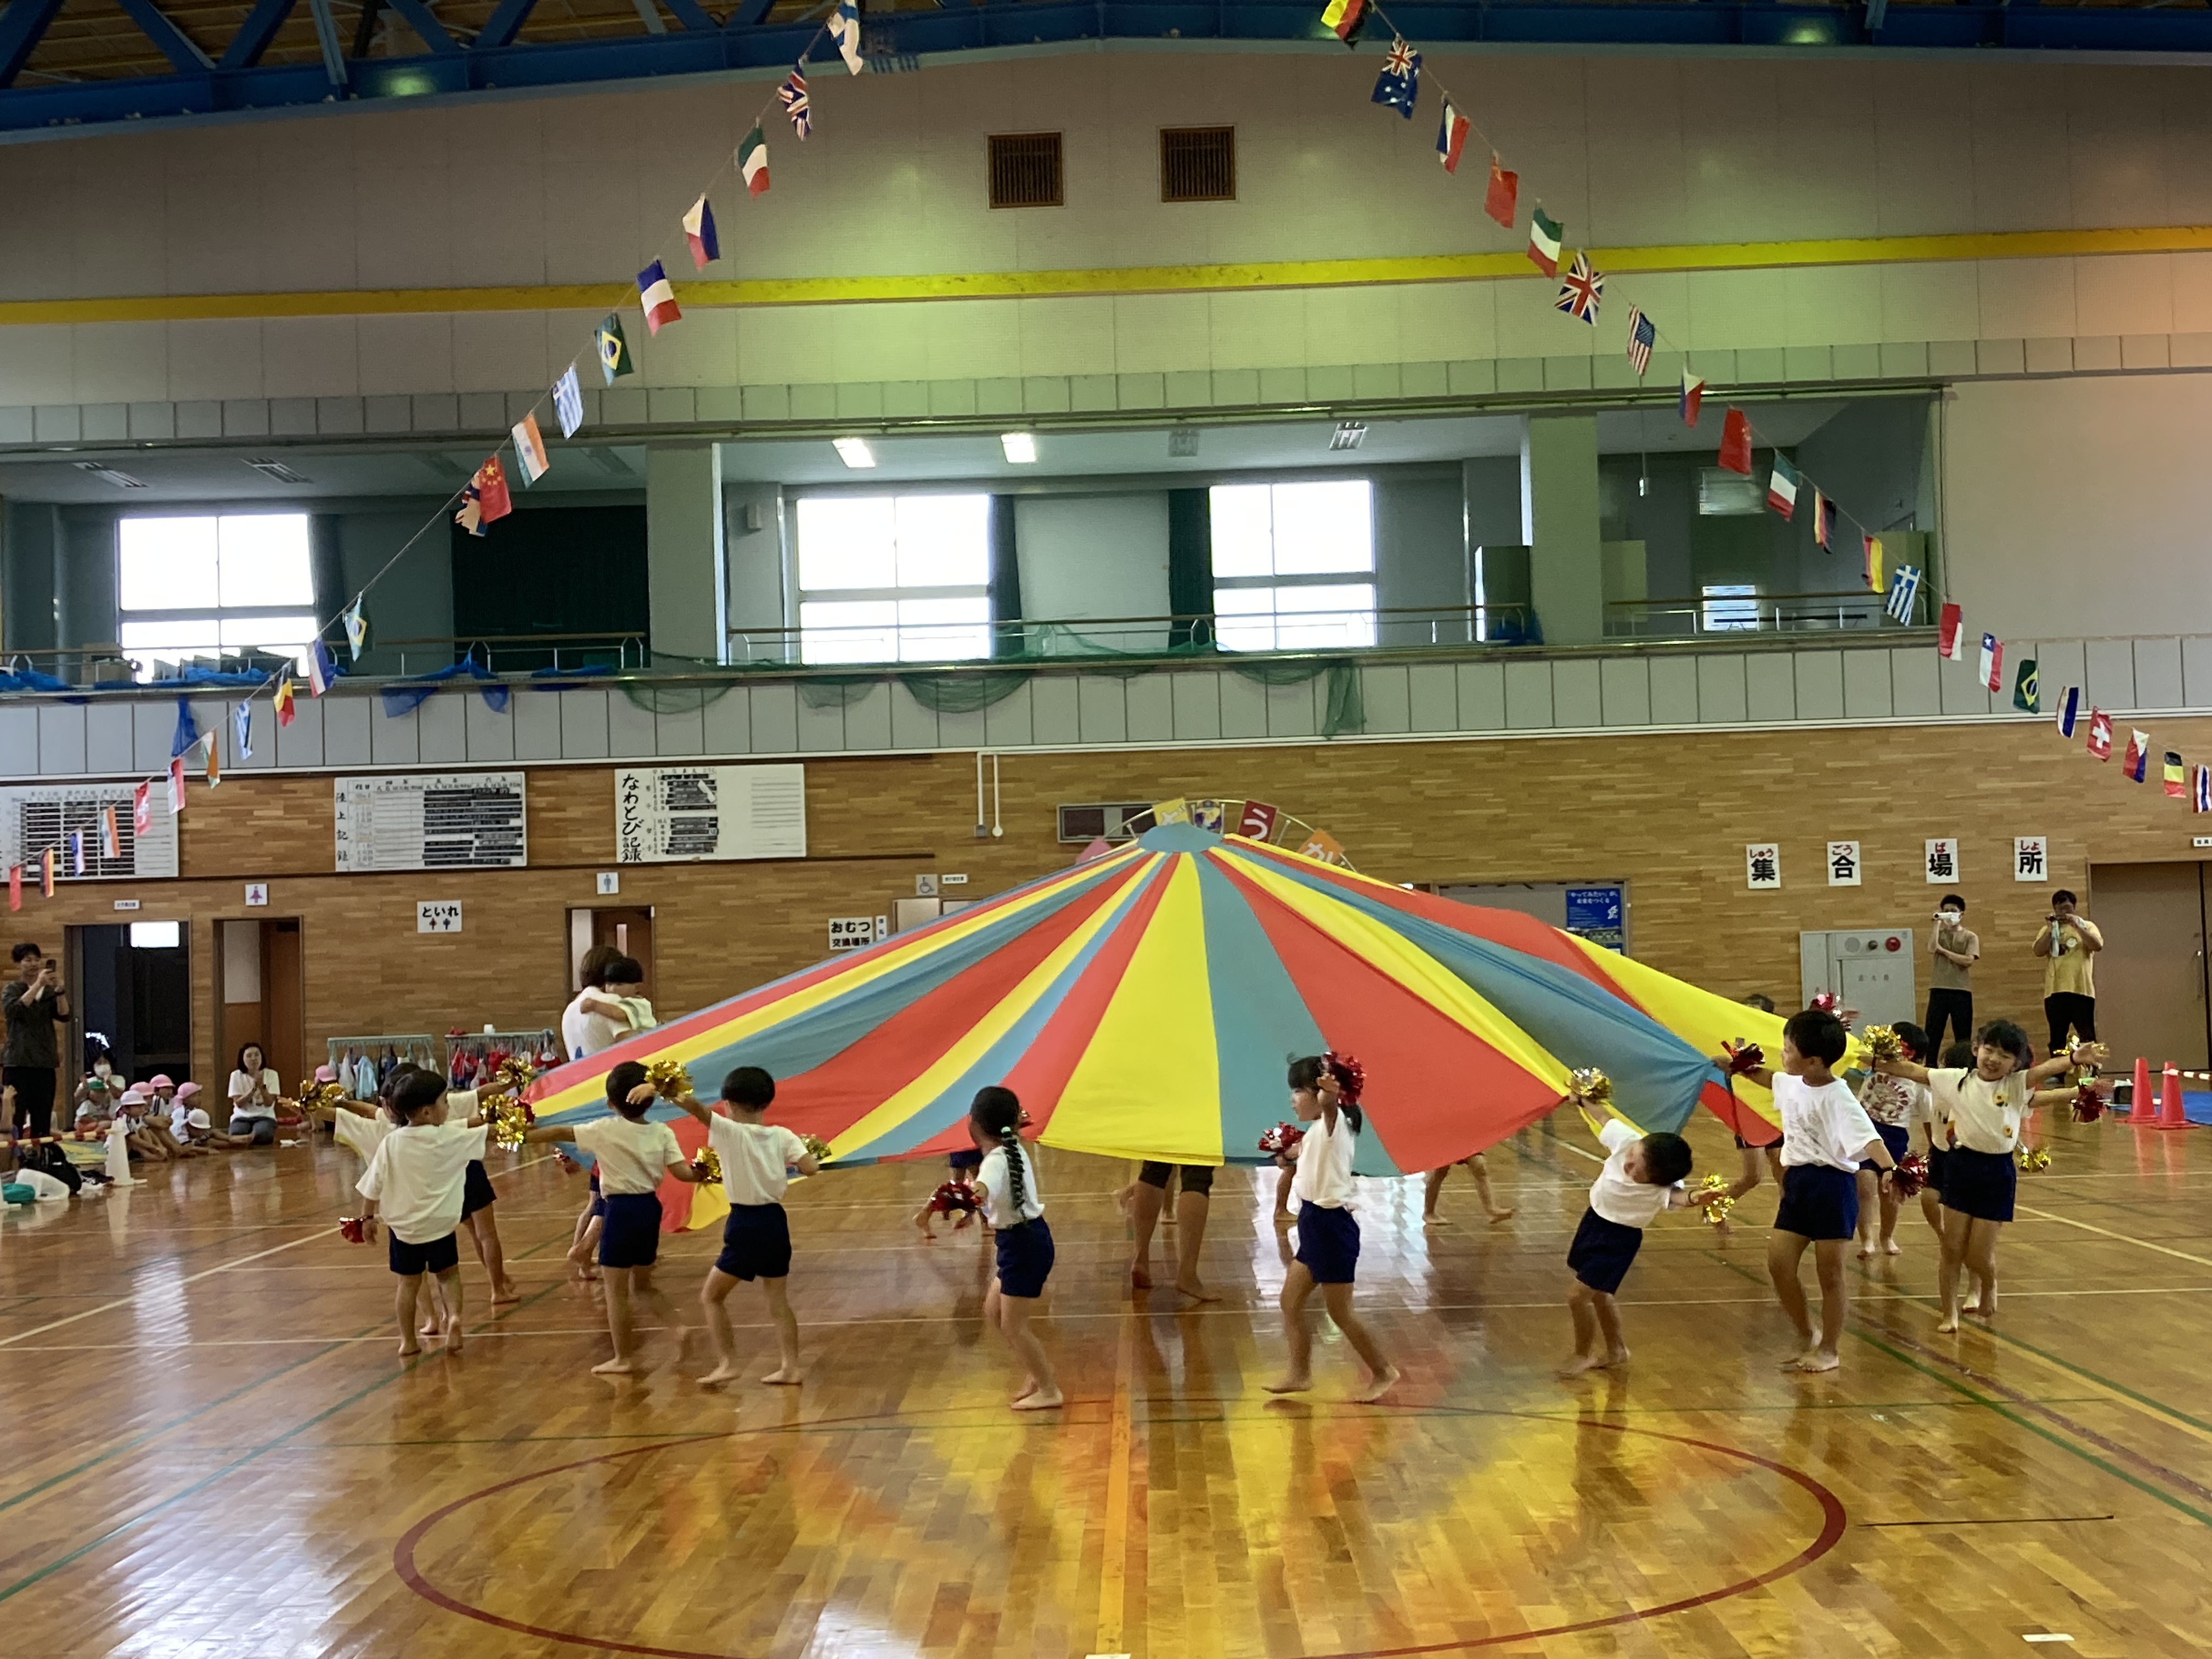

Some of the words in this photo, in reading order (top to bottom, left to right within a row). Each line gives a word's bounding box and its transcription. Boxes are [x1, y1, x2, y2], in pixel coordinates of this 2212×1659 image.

[621, 774, 644, 862] なわとび記録
[1244, 808, 1268, 841] う
[1832, 844, 1853, 856] ごう
[2020, 840, 2040, 851] しょ
[1751, 858, 1775, 882] 集
[1831, 855, 1855, 879] 合
[1928, 853, 1953, 877] 場
[2019, 851, 2042, 874] 所
[422, 906, 459, 918] といれ
[831, 921, 871, 934] おむつ
